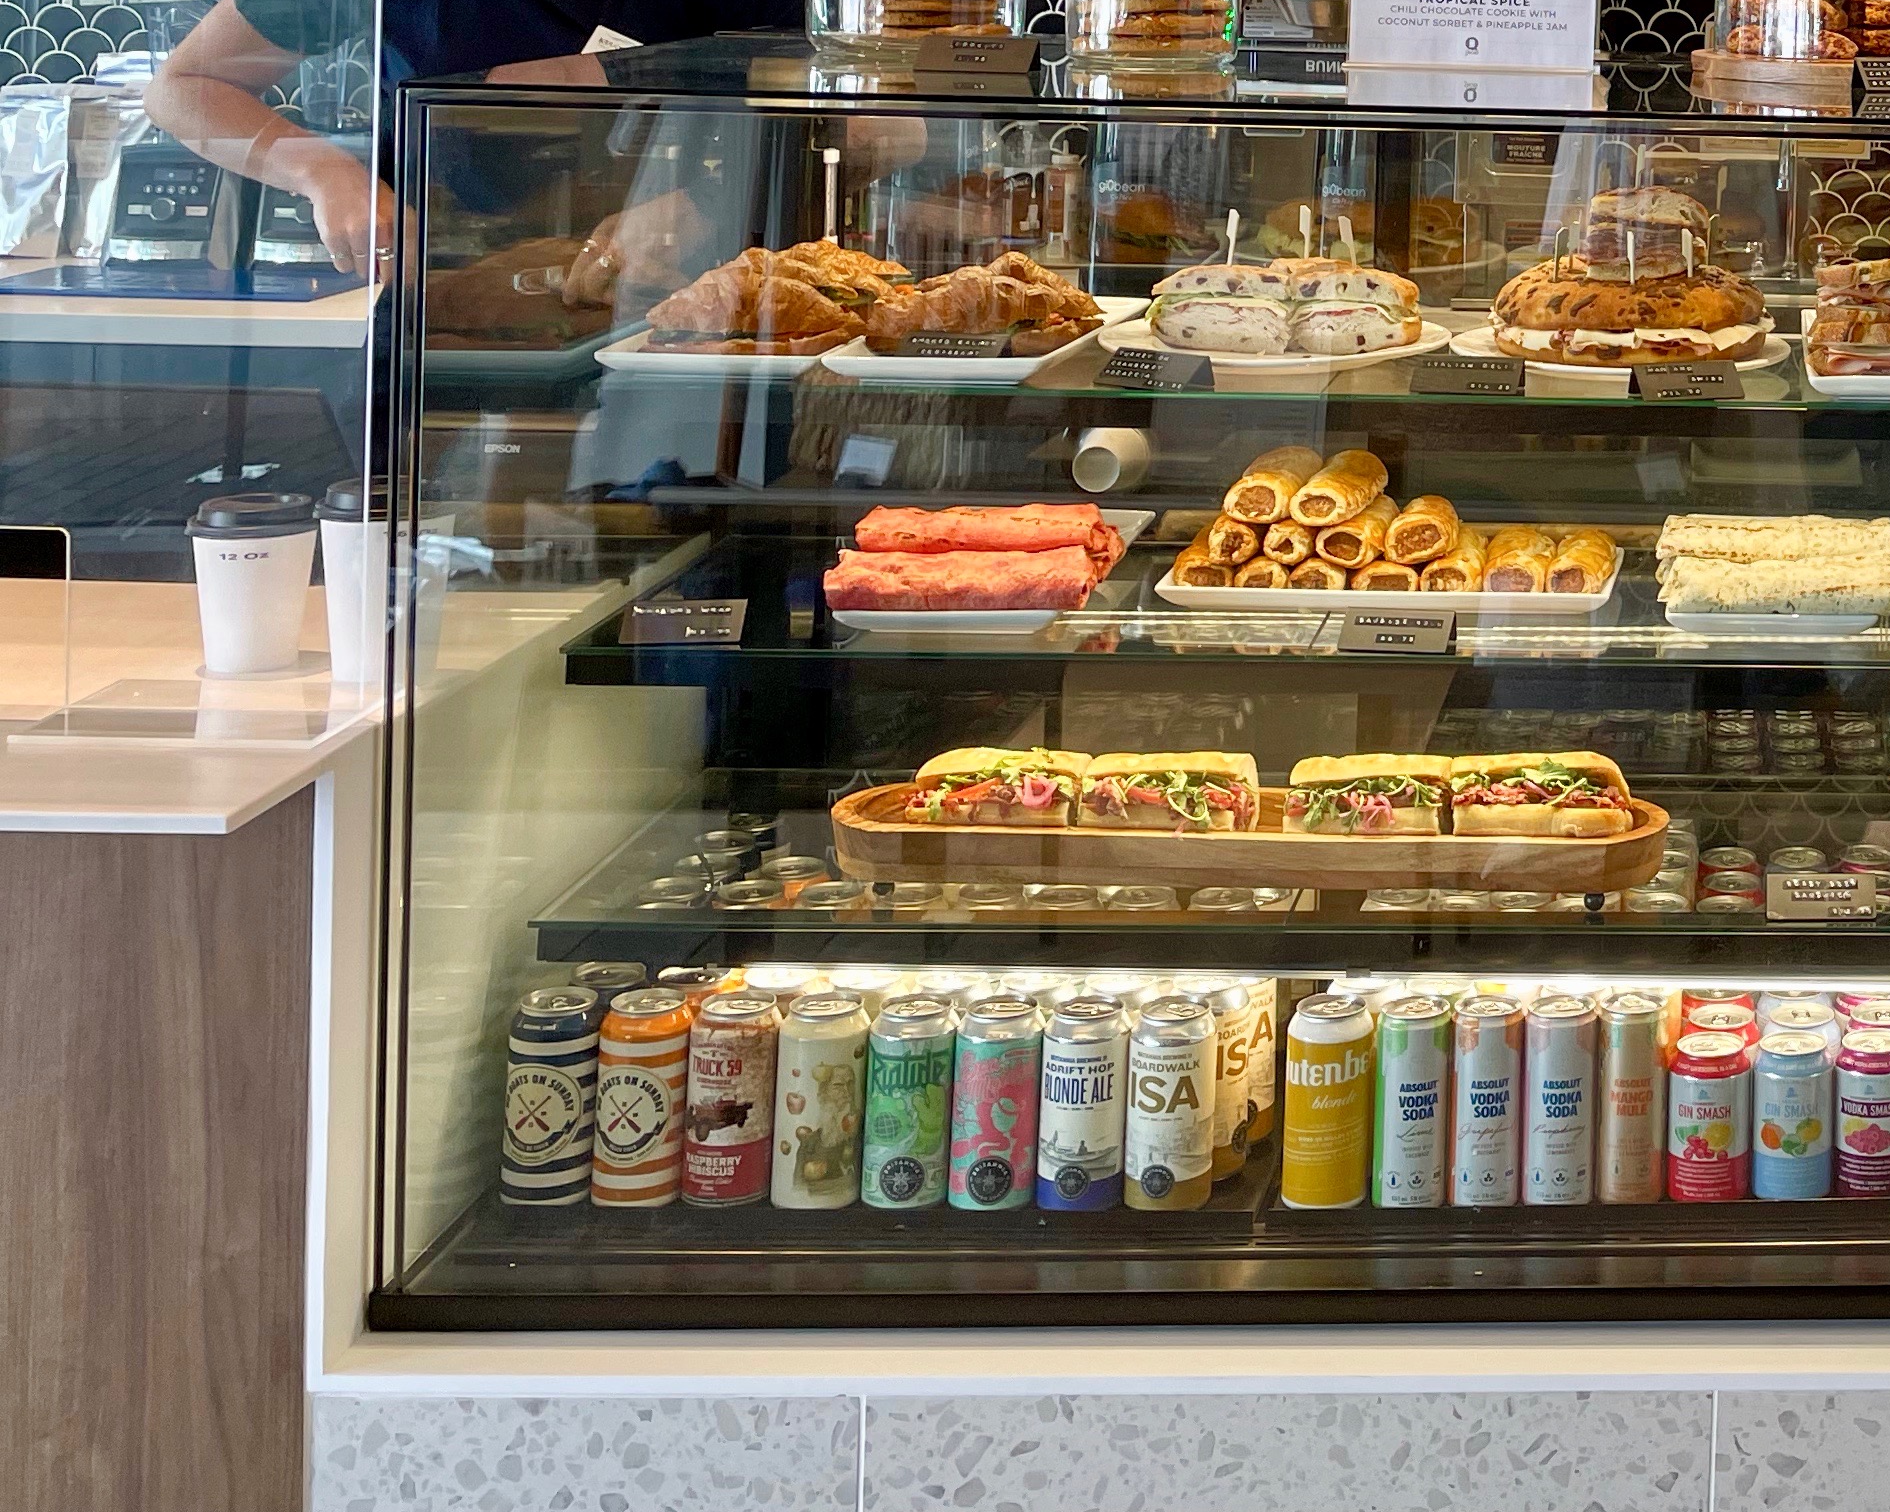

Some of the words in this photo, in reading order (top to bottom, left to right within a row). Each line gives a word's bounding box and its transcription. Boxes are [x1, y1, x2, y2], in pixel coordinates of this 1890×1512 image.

[485, 444, 521, 454] EPSON
[218, 552, 238, 561] 12
[692, 1055, 725, 1078] TRUCK
[727, 1059, 742, 1076] 59
[1046, 1062, 1085, 1075] ADRIFT
[1088, 1061, 1115, 1074] HOP
[1131, 1057, 1201, 1073] BOARDWALK
[1045, 1076, 1088, 1105] BLONDE
[1091, 1073, 1115, 1104] ALE
[1130, 1071, 1200, 1114] ISA
[1400, 1079, 1439, 1093] ABSOLUT
[1398, 1093, 1439, 1109] VODKA
[1843, 1101, 1866, 1117] VODKA
[1402, 1108, 1434, 1121] SODA
[1678, 1104, 1694, 1120] GIN
[1696, 1103, 1731, 1120] SMASH
[686, 1154, 742, 1167] RASPBERRY
